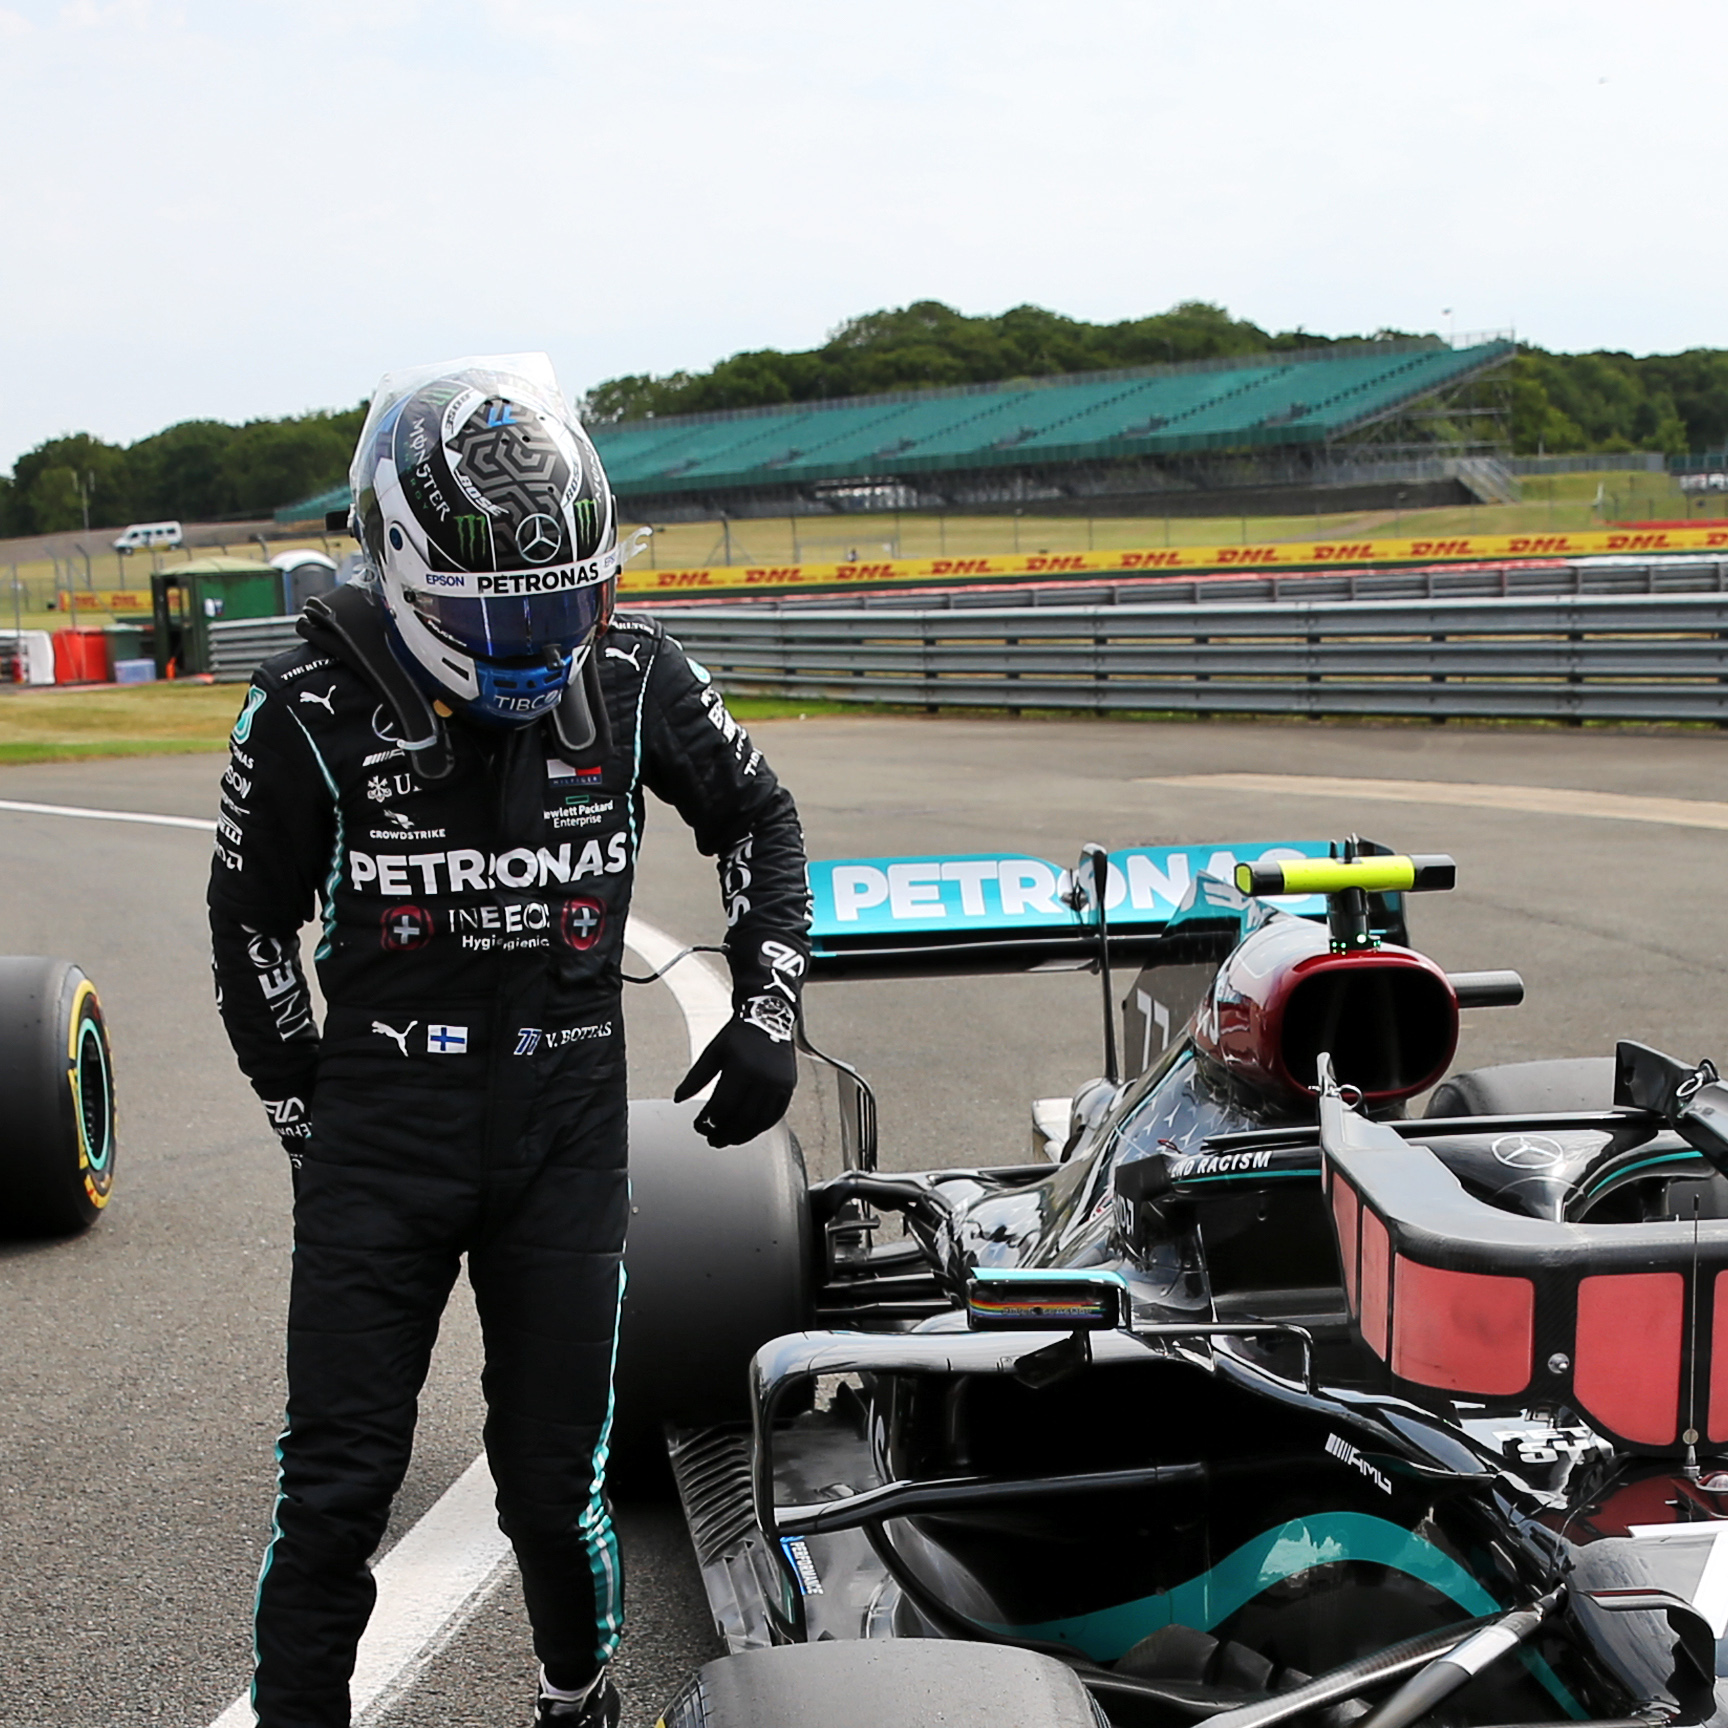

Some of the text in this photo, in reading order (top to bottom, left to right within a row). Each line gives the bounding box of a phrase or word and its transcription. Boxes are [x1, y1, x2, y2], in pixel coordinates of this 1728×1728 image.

[408, 416, 452, 523] MONSTER
[456, 470, 510, 517] BOSE
[1412, 542, 1471, 556] DHL
[1509, 539, 1569, 553] DHL
[1607, 535, 1670, 549] DHL
[1217, 549, 1276, 564] DHL
[1314, 545, 1374, 560] DHL
[932, 561, 990, 575] DHL
[1027, 557, 1086, 571] DHL
[1122, 553, 1180, 568] DHL
[425, 573, 466, 587] EPSON
[477, 562, 599, 595] PETRONAS
[658, 573, 711, 587] DHL
[746, 569, 802, 583] DHL
[837, 565, 894, 580] DHL
[543, 799, 614, 820] ewlett Packard
[553, 813, 603, 829] Enterprise
[369, 828, 447, 841] CROWDSTRIKE
[349, 832, 628, 896] PETRONAS
[1136, 987, 1170, 1073] 77
[513, 1021, 613, 1056] 77 V. BOTTAS
[1196, 1150, 1273, 1175] RACISM
[1347, 1448, 1393, 1495] AMG
